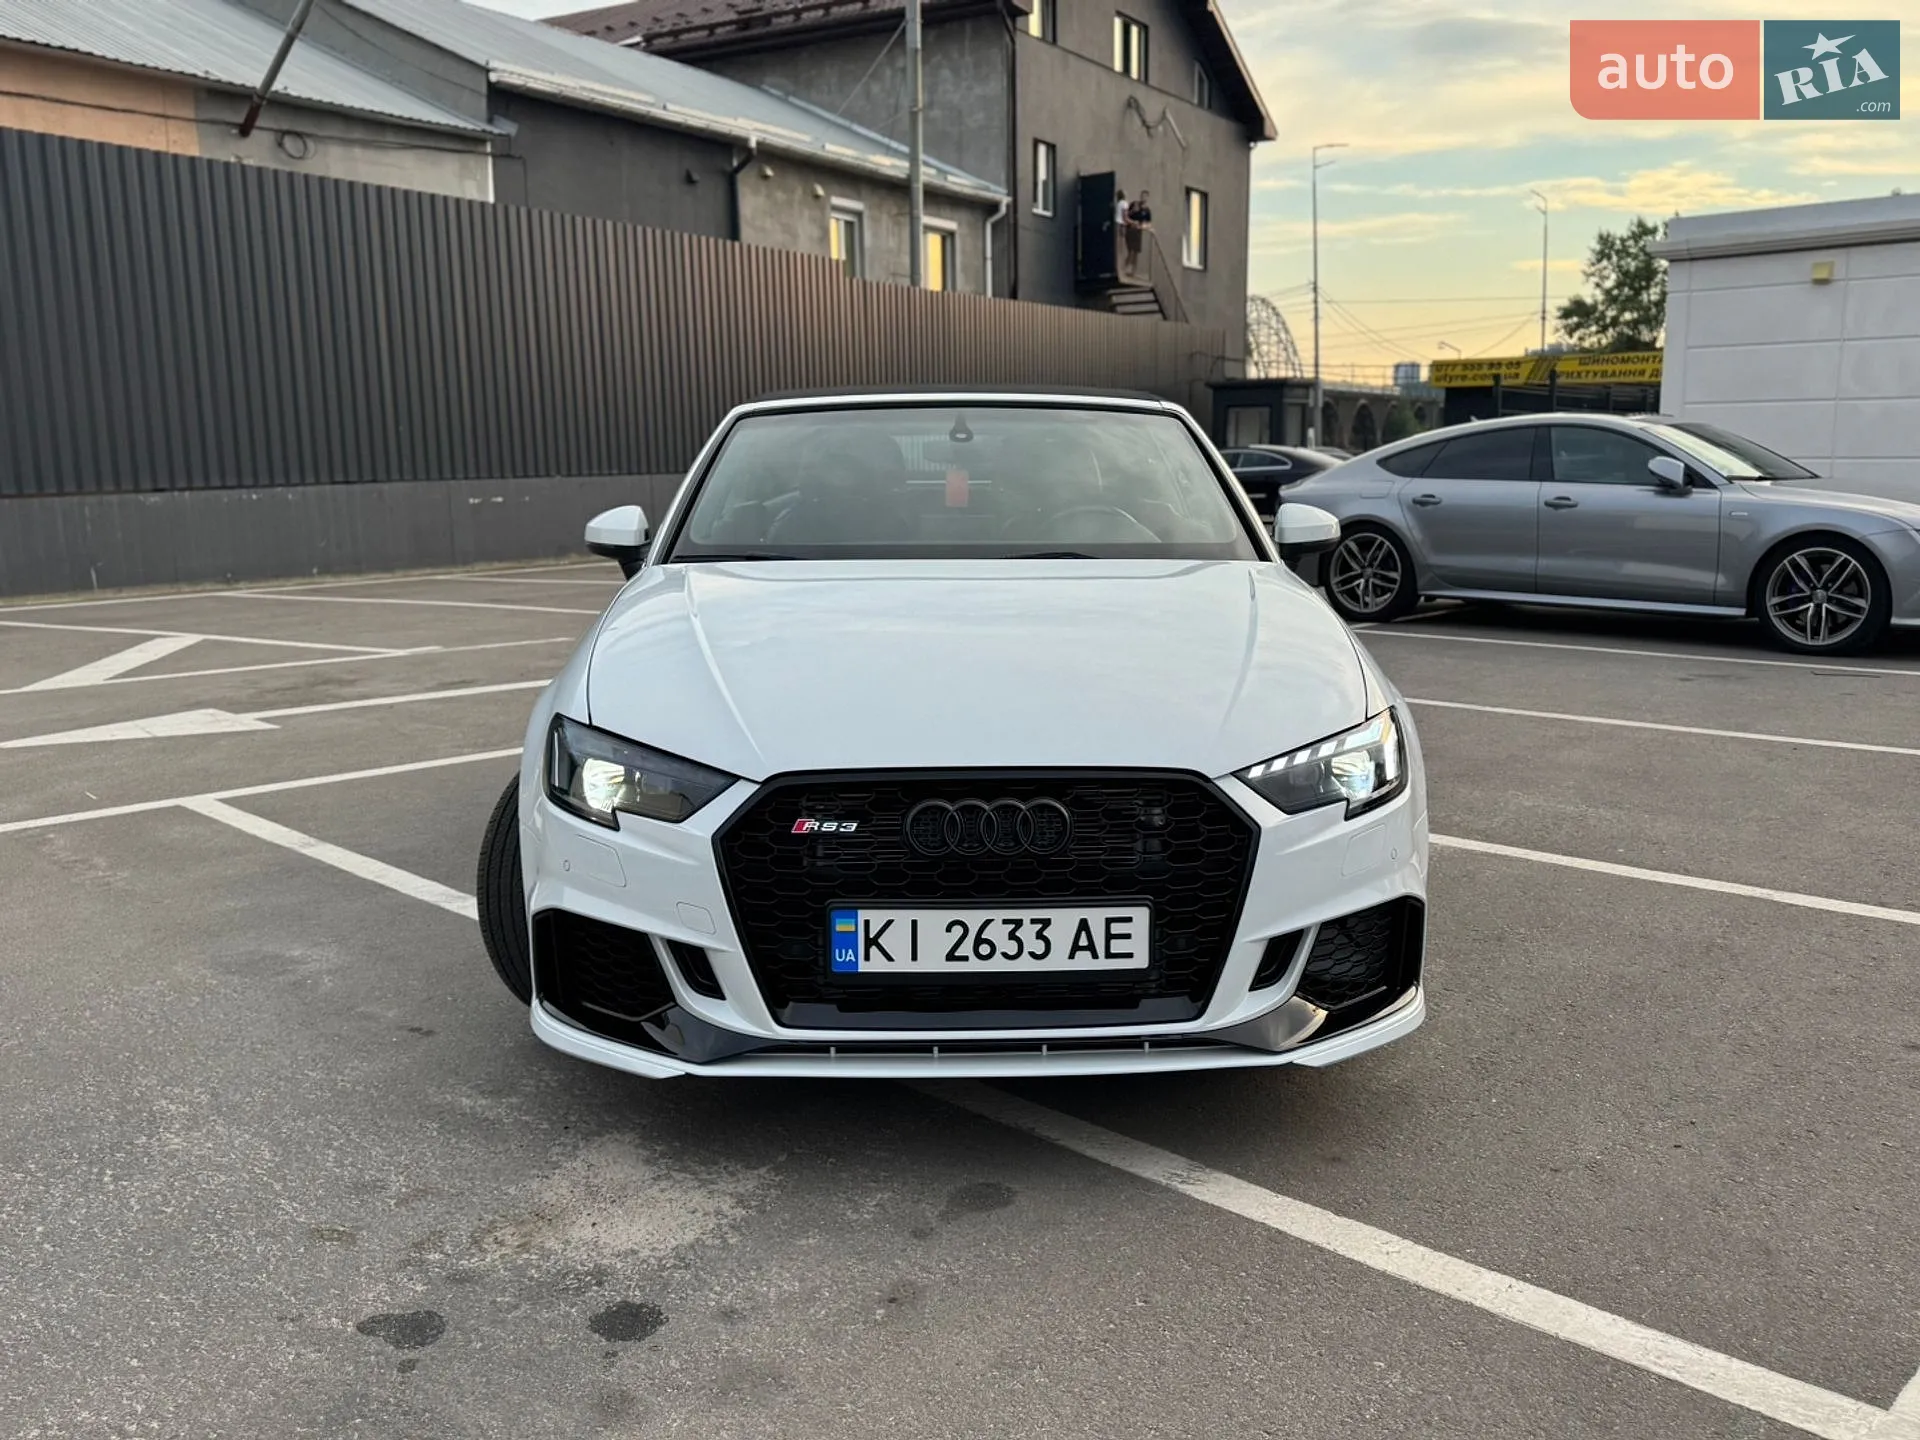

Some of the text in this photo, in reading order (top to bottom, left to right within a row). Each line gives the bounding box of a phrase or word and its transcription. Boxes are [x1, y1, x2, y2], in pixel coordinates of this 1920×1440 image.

[799, 819, 859, 832] RS3
[863, 916, 1135, 962] KI 2633 AE
[835, 948, 856, 963] UA
